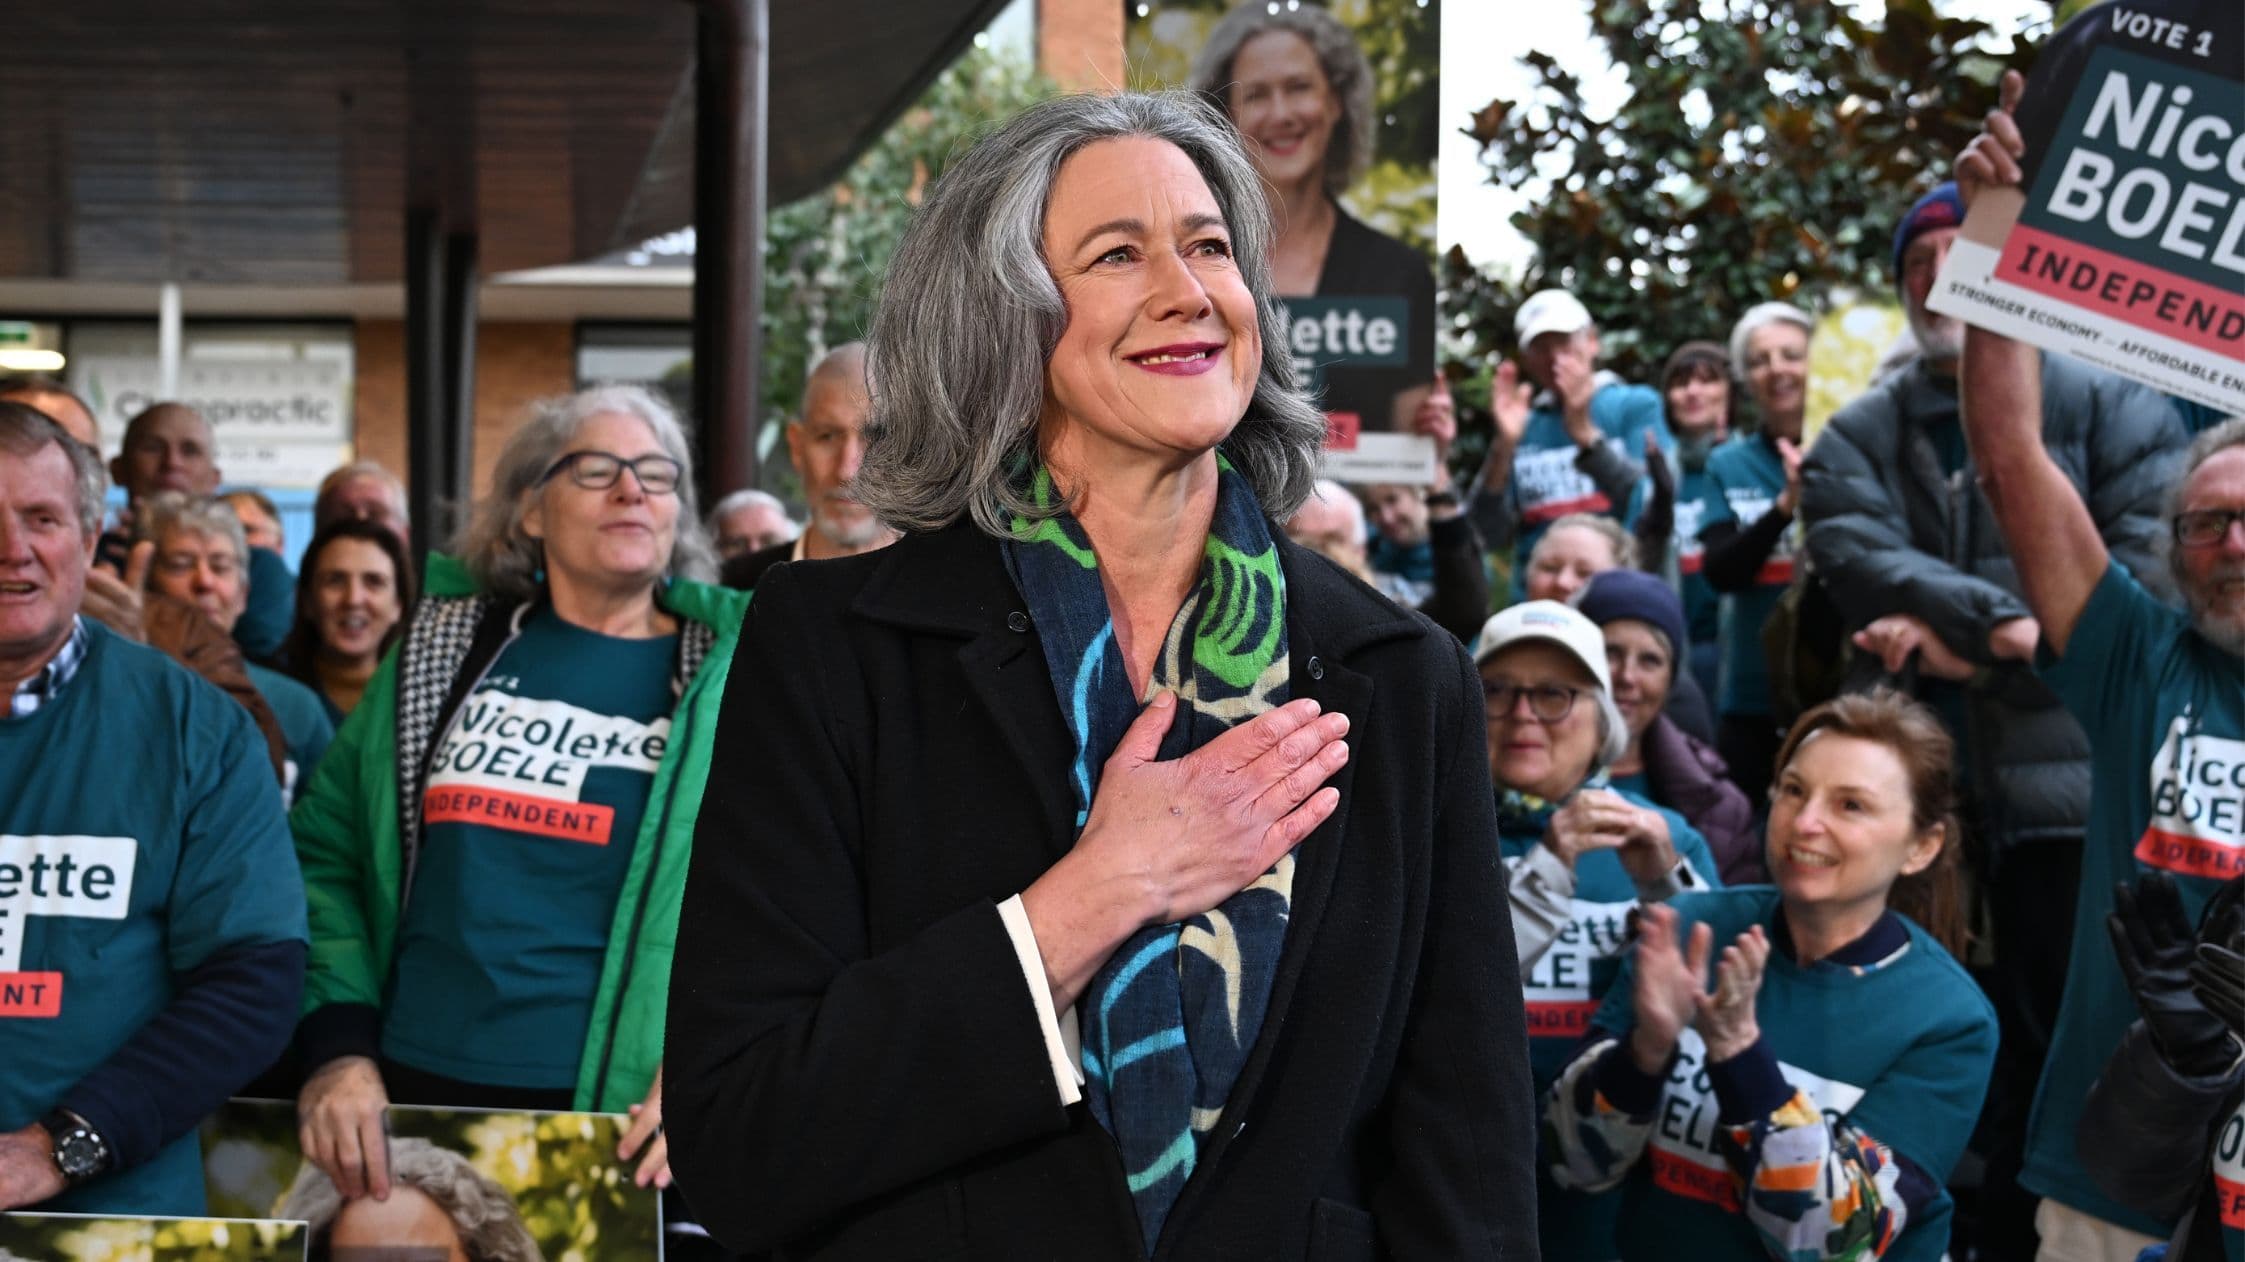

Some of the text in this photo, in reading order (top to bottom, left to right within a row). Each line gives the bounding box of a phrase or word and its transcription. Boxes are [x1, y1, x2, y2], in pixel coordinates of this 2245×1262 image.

[2110, 6, 2214, 57] VOTE 1
[2016, 243, 2245, 341] INDEPEND
[1280, 307, 1397, 355] ette
[1949, 281, 2027, 317] STRONGER
[2027, 308, 2102, 341] ECONOMY
[2118, 340, 2221, 384] AFFORDABLE
[2221, 373, 2245, 396] EN
[2155, 778, 2245, 834] BOE
[1557, 914, 1624, 946] ett
[4, 982, 47, 1006] NT
